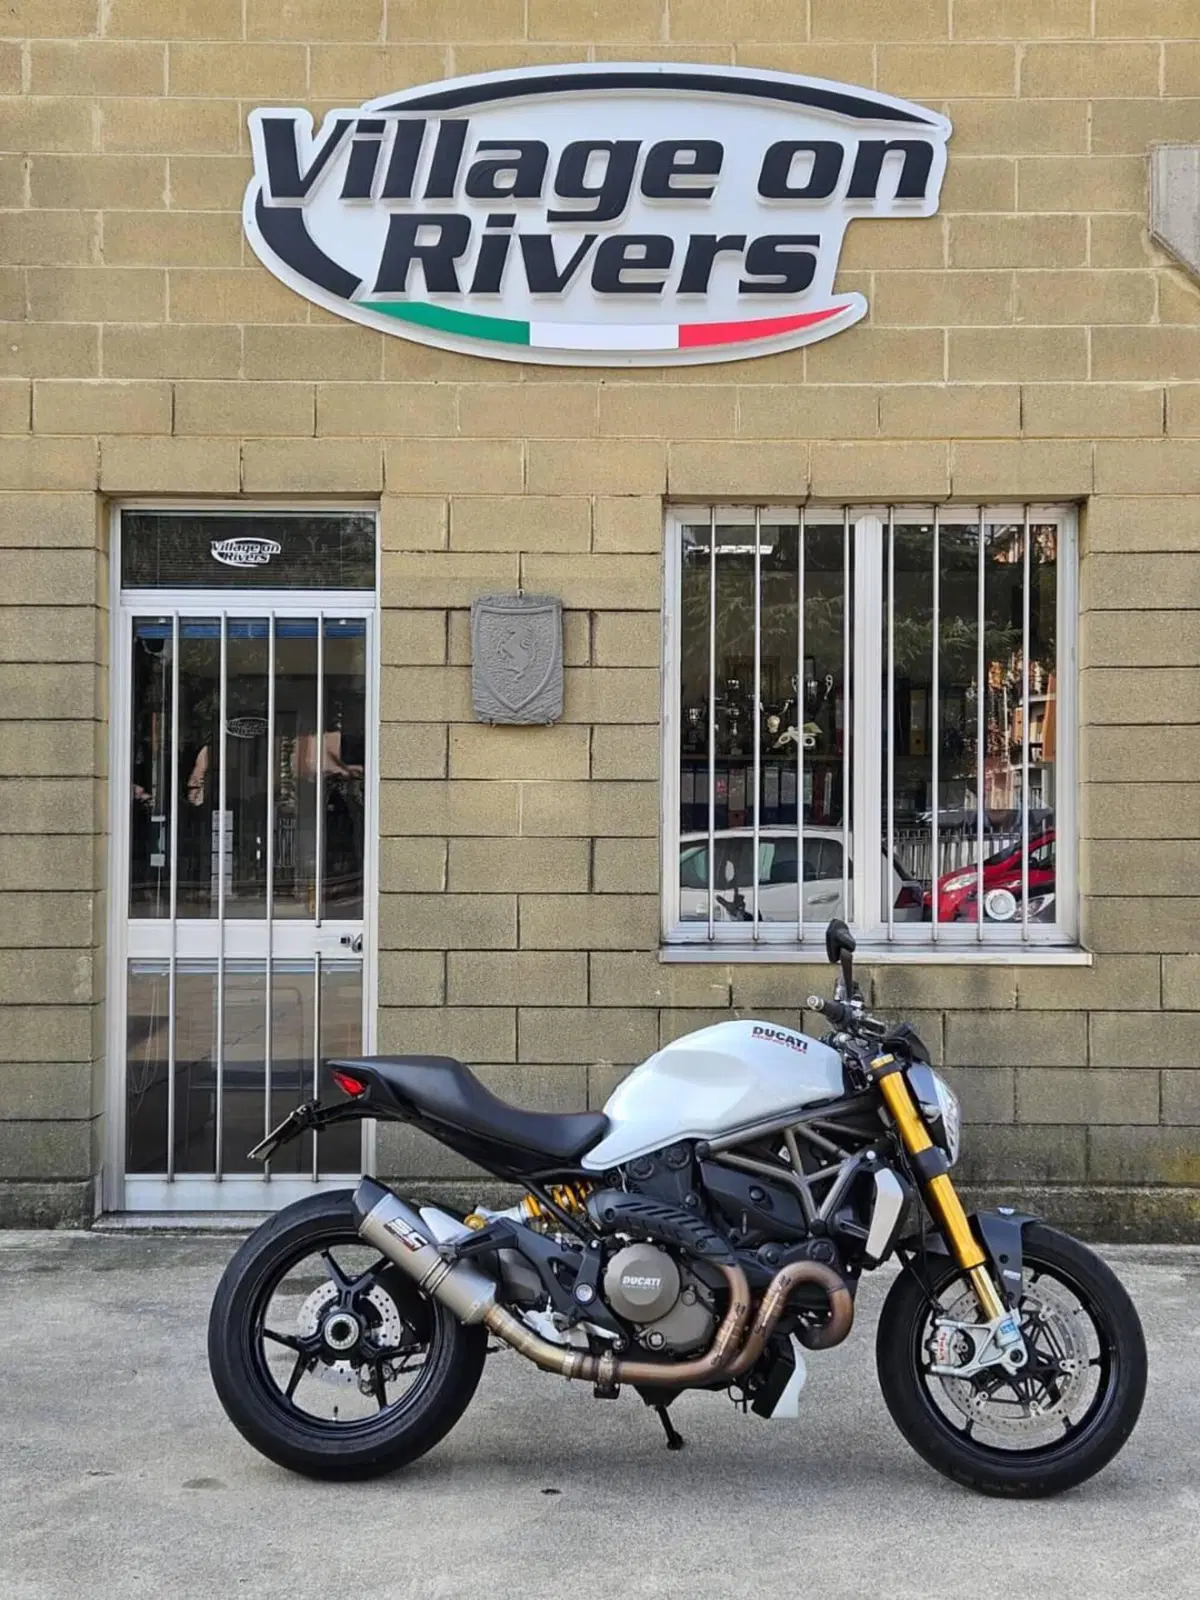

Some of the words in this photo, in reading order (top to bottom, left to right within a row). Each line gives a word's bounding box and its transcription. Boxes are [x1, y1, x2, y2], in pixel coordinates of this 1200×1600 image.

[261, 118, 725, 223] Village
[755, 139, 935, 201] on
[373, 213, 821, 295] Rivers
[212, 541, 259, 554] Village
[752, 1026, 808, 1050] DUCATI
[622, 1276, 661, 1287] DUCATI
